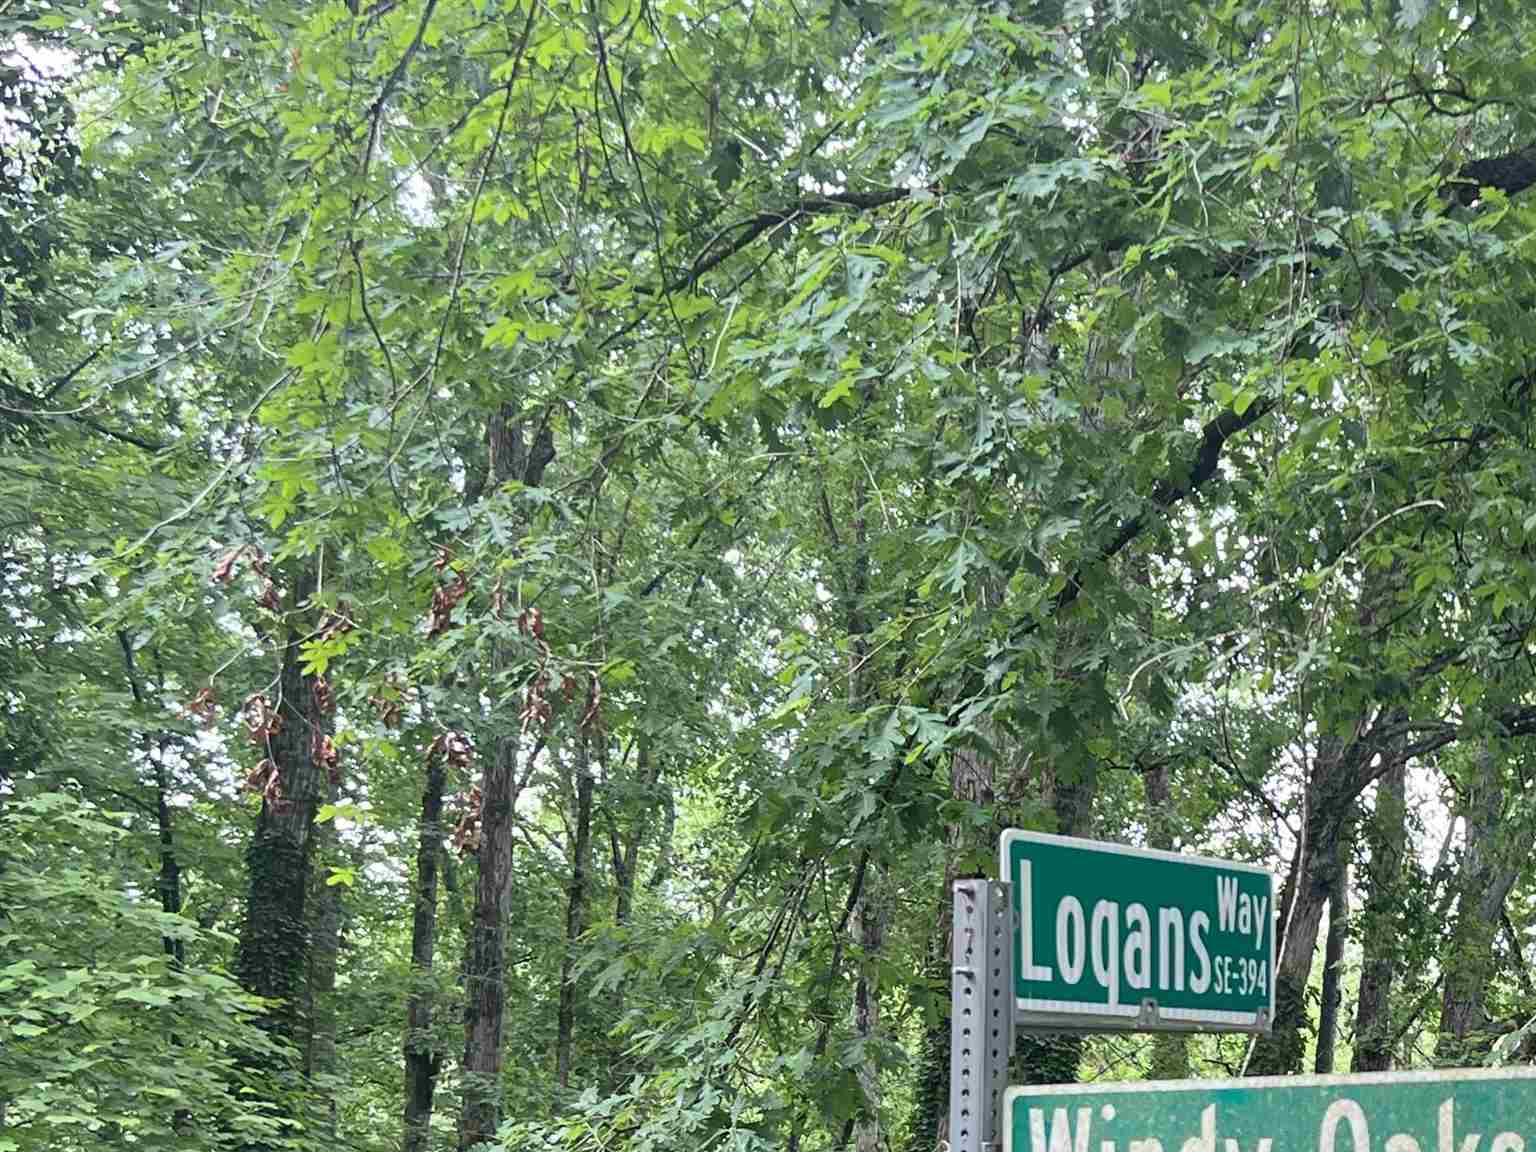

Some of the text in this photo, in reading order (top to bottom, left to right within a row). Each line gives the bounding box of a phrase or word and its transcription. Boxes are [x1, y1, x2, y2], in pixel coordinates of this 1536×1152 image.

[1020, 859, 1267, 1006] Logans Way
[1214, 956, 1266, 996] SE-394
